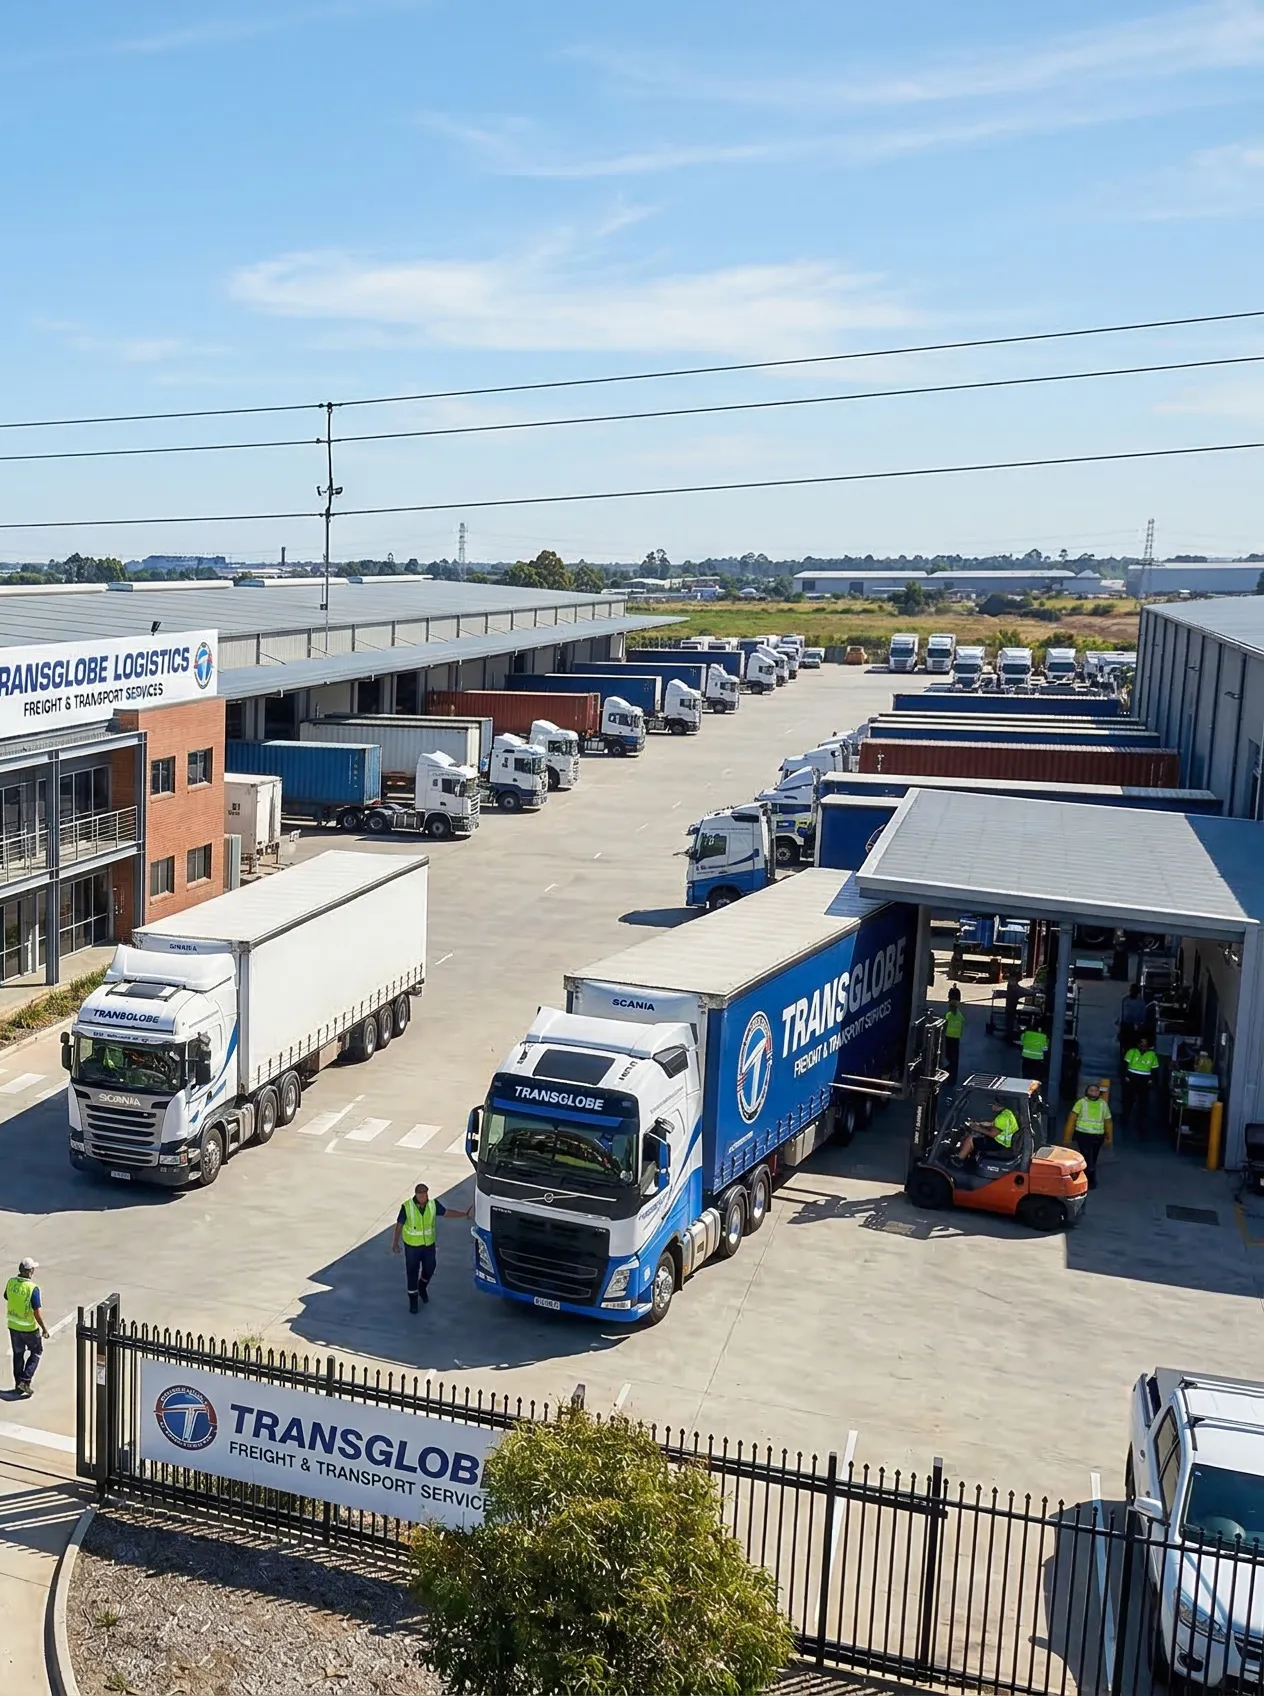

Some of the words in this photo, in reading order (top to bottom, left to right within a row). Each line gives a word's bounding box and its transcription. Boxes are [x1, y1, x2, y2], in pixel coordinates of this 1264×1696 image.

[113, 647, 190, 681] LOGISTICS
[23, 697, 63, 717] FREIGHT
[612, 998, 655, 1012] SCANIA
[782, 936, 906, 1058] TRANSGLOBE
[515, 1086, 604, 1111] TRANSGLOBE
[230, 1403, 492, 1489] TRANSGLOB
[229, 1441, 294, 1469] FREIGHT
[300, 1457, 310, 1472] &
[316, 1461, 415, 1497] TRANSPORT
